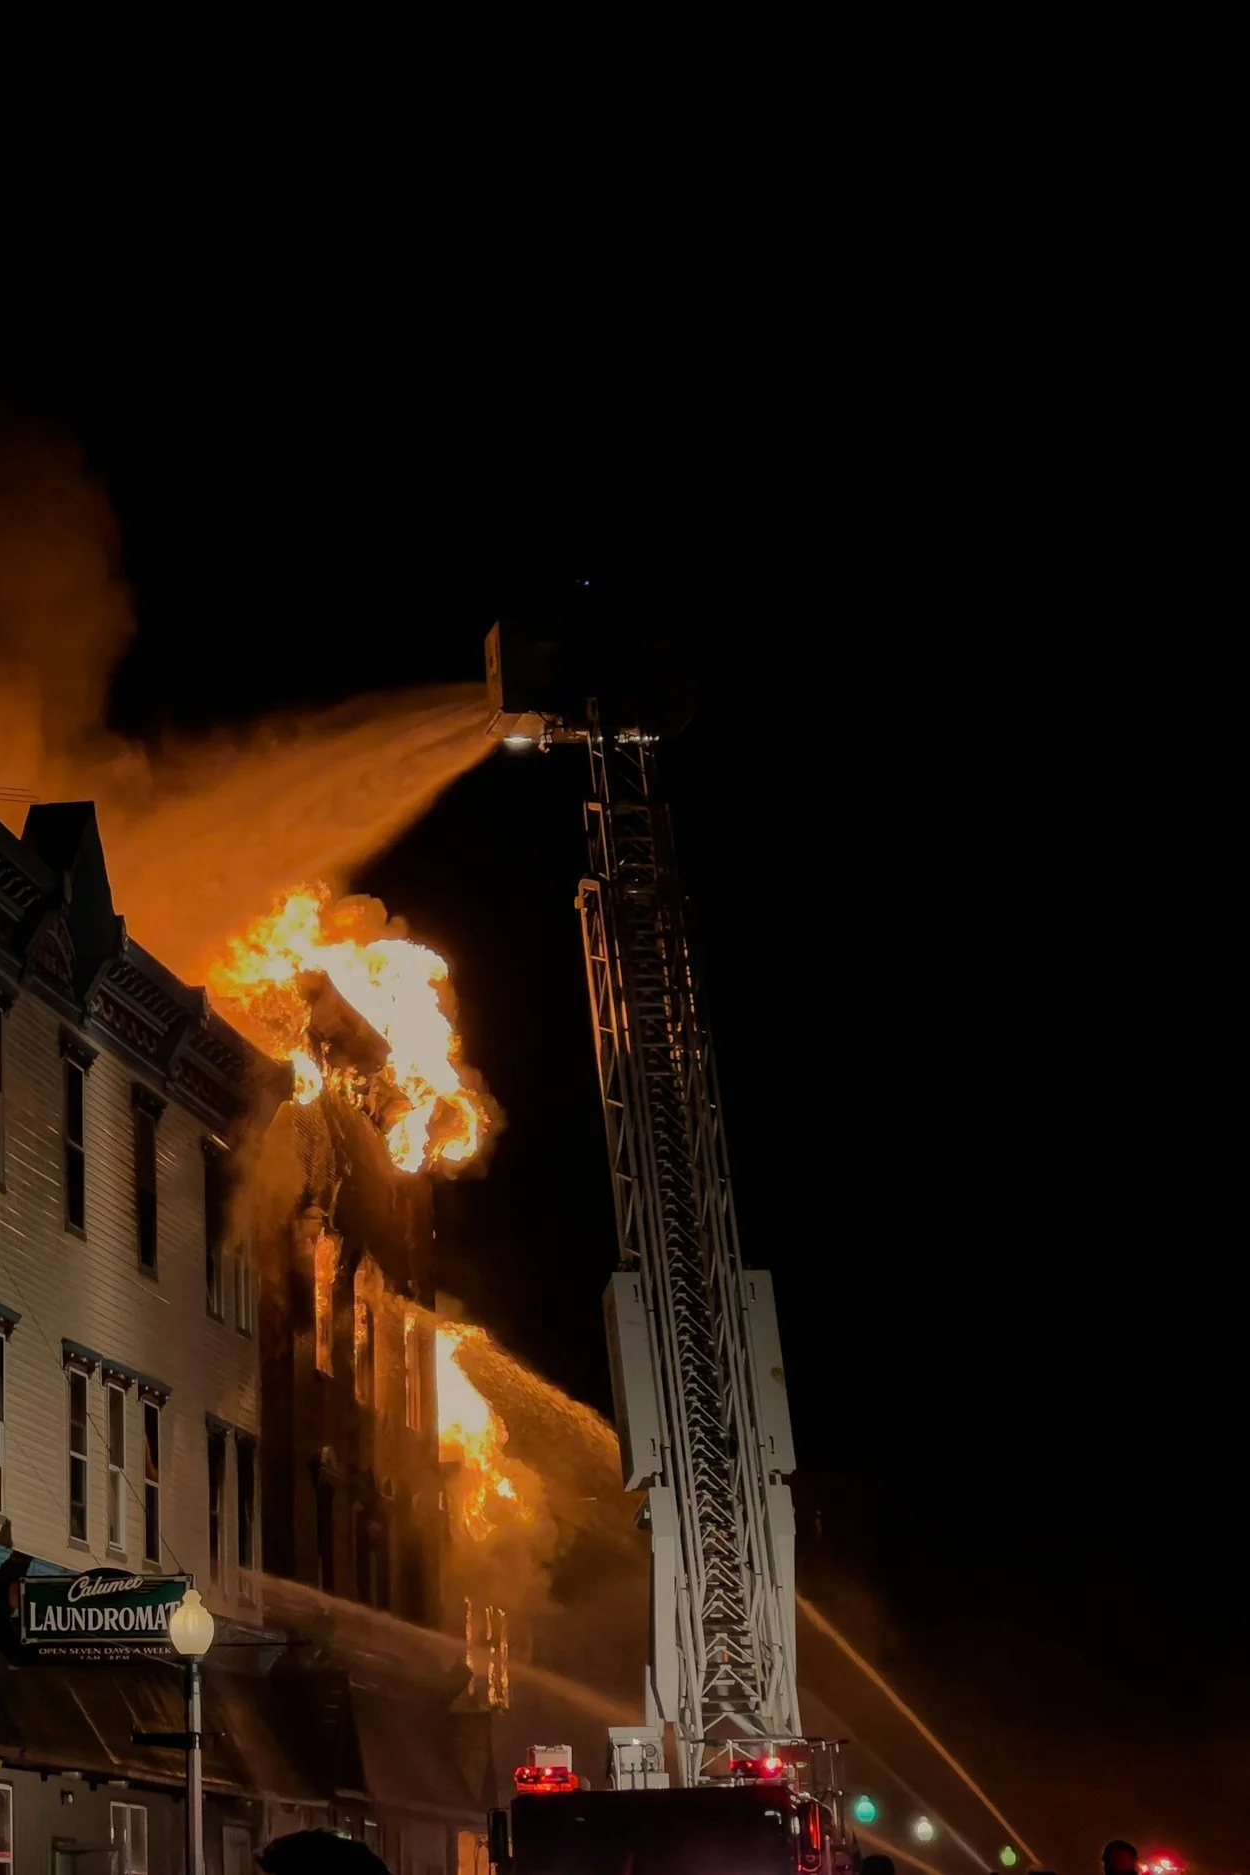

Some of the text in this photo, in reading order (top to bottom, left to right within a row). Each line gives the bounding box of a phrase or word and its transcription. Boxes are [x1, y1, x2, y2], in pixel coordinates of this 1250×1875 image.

[67, 1576, 144, 1602] Calumet
[29, 1600, 180, 1631] LAUNDROMAT
[38, 1647, 171, 1655] OPEN SEVEN DAYS A WEEK
